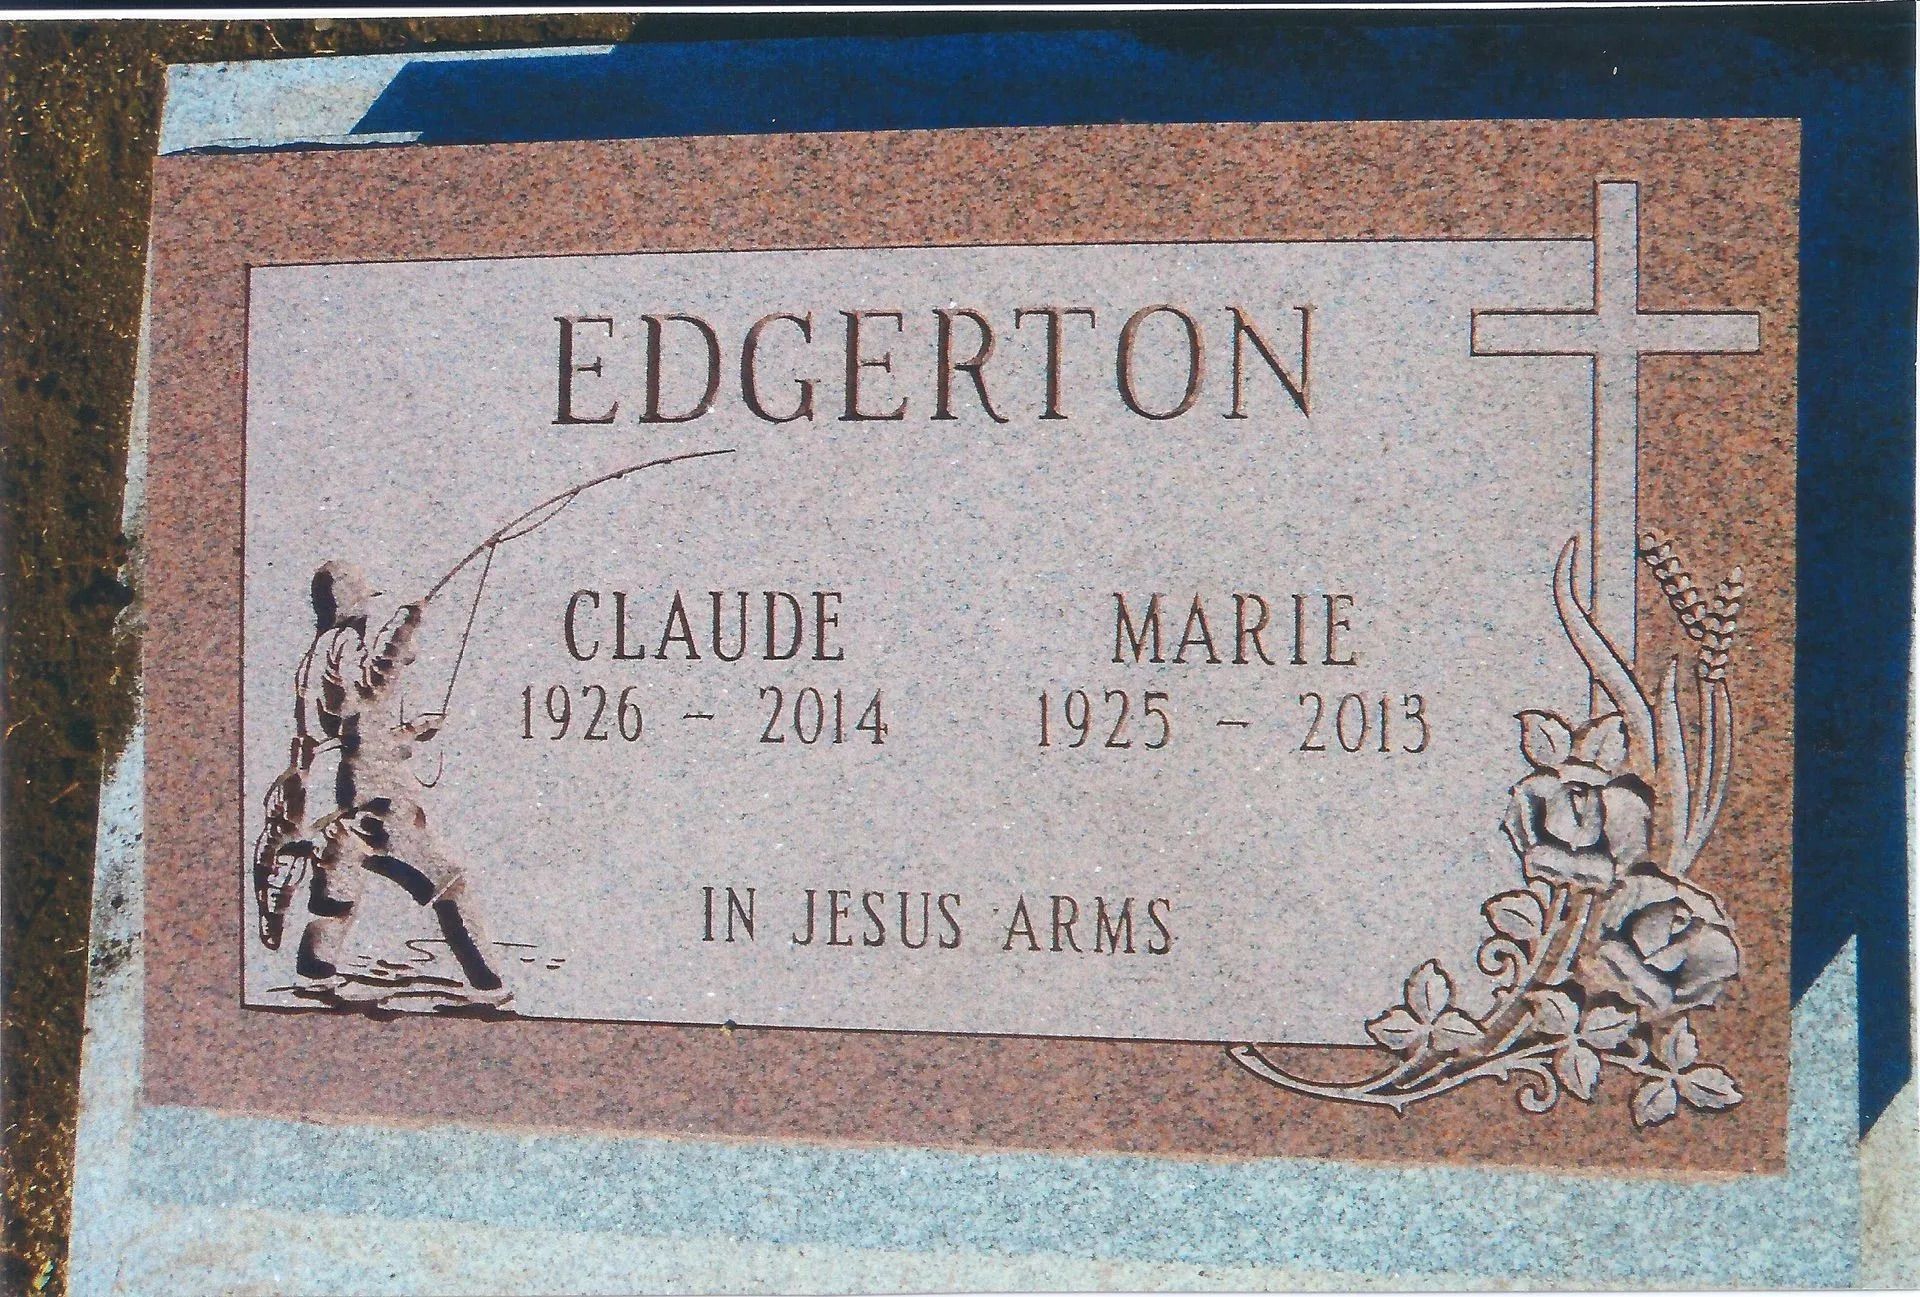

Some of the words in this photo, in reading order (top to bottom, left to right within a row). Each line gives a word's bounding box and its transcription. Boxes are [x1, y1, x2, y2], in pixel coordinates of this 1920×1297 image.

[551, 304, 1314, 425] EDGERTON
[564, 589, 845, 663] CLAUDE
[1111, 592, 1357, 666] MARIE
[521, 684, 643, 742] 1926
[759, 685, 888, 745] 2014
[1038, 689, 1170, 750] 1925
[1298, 692, 1430, 754] 2013
[702, 886, 756, 943] IN
[792, 889, 962, 950] JESUS
[1002, 895, 1172, 956] ARMS
